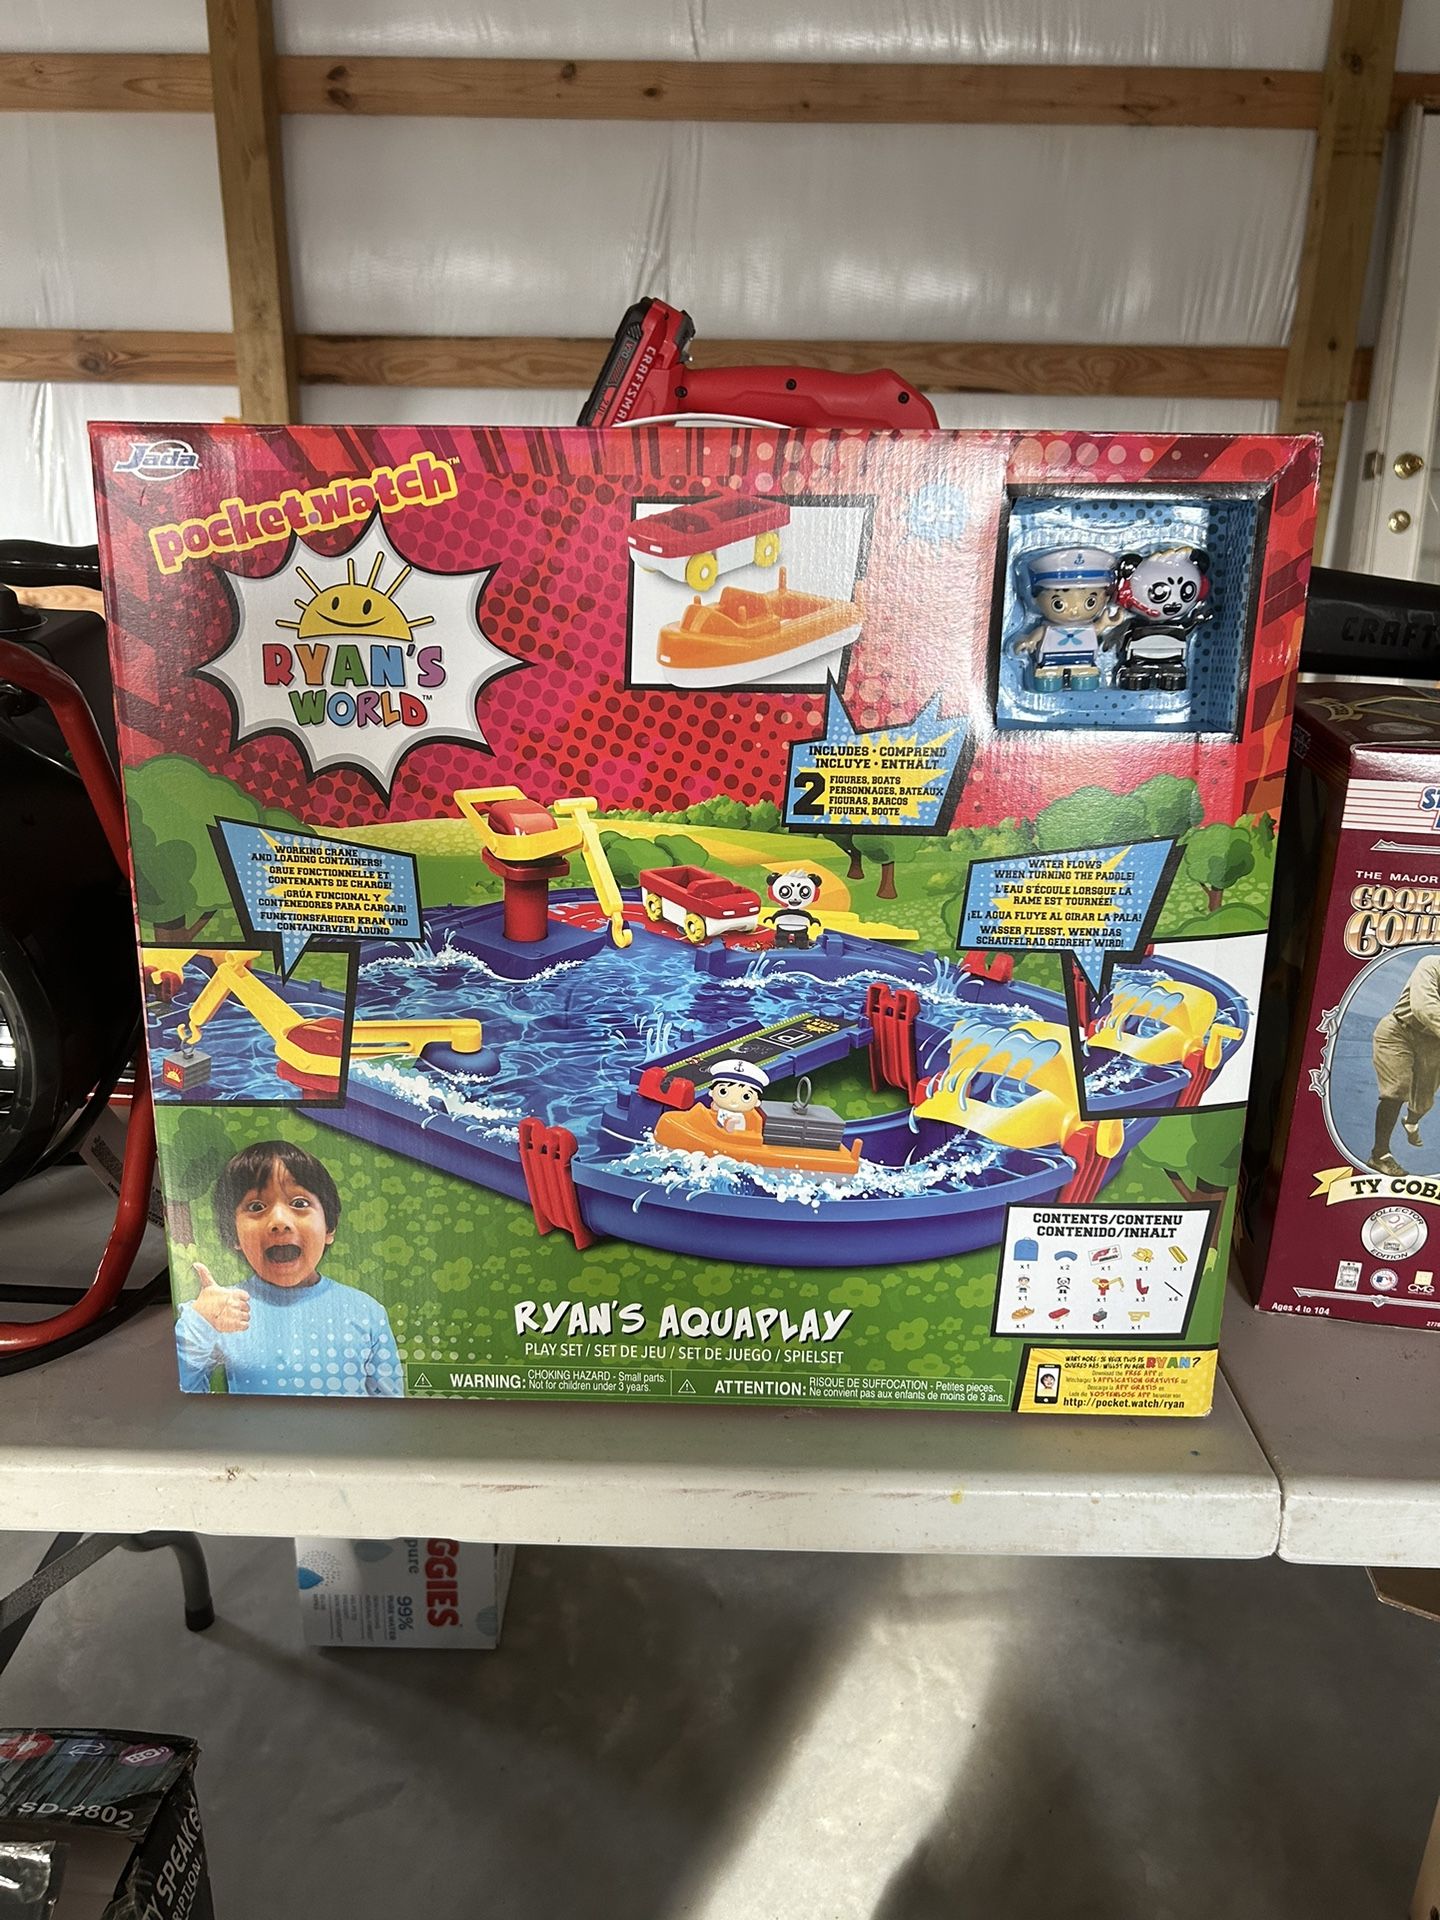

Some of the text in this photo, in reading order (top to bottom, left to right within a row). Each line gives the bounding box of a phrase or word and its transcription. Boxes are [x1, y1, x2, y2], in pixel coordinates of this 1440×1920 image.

[114, 442, 197, 471] Jada
[150, 453, 458, 574] pocket.watch
[262, 643, 446, 688] RYAN'S
[289, 689, 429, 728] WORLD
[809, 745, 947, 757] INCLUDES COMPREND
[816, 757, 939, 770] INCLUYE ENTHÄLT
[829, 775, 901, 785] FIGURES, BOATS
[793, 772, 826, 816] 2
[829, 786, 944, 796] PERSONNAGES, BATEAUX
[829, 796, 909, 806] FIGURAS, BARCOS
[828, 807, 900, 816] FIGUREN, BOOTE
[274, 846, 358, 857] WORKING CRANE
[251, 853, 383, 867] AND LOADING CONTAINERS!
[1028, 859, 1103, 869] WATER FLOWS
[269, 866, 390, 880] GRUE FONCTIONNELLE ET
[994, 869, 1136, 880] WHEN TURNING THE PADDLE!
[1355, 870, 1439, 884] THE MAJOR
[268, 876, 392, 889] CONTENANTS DE CHARGE!
[995, 883, 1133, 896] L'EAU S'ÉCOULE LORSQUE LA
[315, 891, 371, 901] FUNCIONAL
[373, 893, 381, 902] Y
[1013, 895, 1112, 906] RAME EST TOURNÉE!
[258, 898, 407, 913] CONTENEDORES PARA CARGAR!
[357, 916, 386, 925] KRAN
[387, 917, 409, 926] UND
[985, 911, 1012, 919] AGUA
[1014, 911, 1047, 920] FLUYE
[1049, 912, 1062, 920] AL
[1065, 912, 1095, 921] GIRAR
[1097, 913, 1110, 921] LA
[1113, 913, 1142, 922] PALA!
[277, 922, 390, 935] CONTAINERVERLADUNG
[980, 925, 1122, 937] WASSER FLIESST, WENN DAS
[976, 936, 1124, 947] SCHAUFELRAD GEDREHT WIRD!
[1351, 1178, 1440, 1201] TY COB
[1033, 1212, 1183, 1225] CONTENTS/CONTENU
[1370, 1207, 1424, 1225] COLLECTOR
[1036, 1226, 1178, 1239] CONTENIDO/INHALT
[1370, 1248, 1409, 1260] EDITION
[1271, 1302, 1330, 1316] Ages 4 to 104
[514, 1300, 853, 1344] RYAN'S AQUAPLAY
[525, 1342, 844, 1364] PLAY SET SET DE JEU SET DE JUEGO SPIELSET
[450, 1373, 526, 1389] WARNING:
[527, 1369, 667, 1383] CHOKING HAZARD Small parts.
[809, 1376, 845, 1388] RISQUE
[847, 1378, 860, 1388] DE
[862, 1378, 928, 1390] SUFFOCATION
[528, 1379, 651, 1393] Not for children under 3 years.
[714, 1380, 807, 1396] ATTENTION:
[809, 1386, 1006, 1402] Ne convient pas aux enfants de moins de 3 ans.
[1063, 1397, 1185, 1410] http://pocket.watch/ryan
[404, 1539, 420, 1574] pure
[397, 1596, 414, 1631] 99%
[17, 1802, 135, 1829] SD-2802
